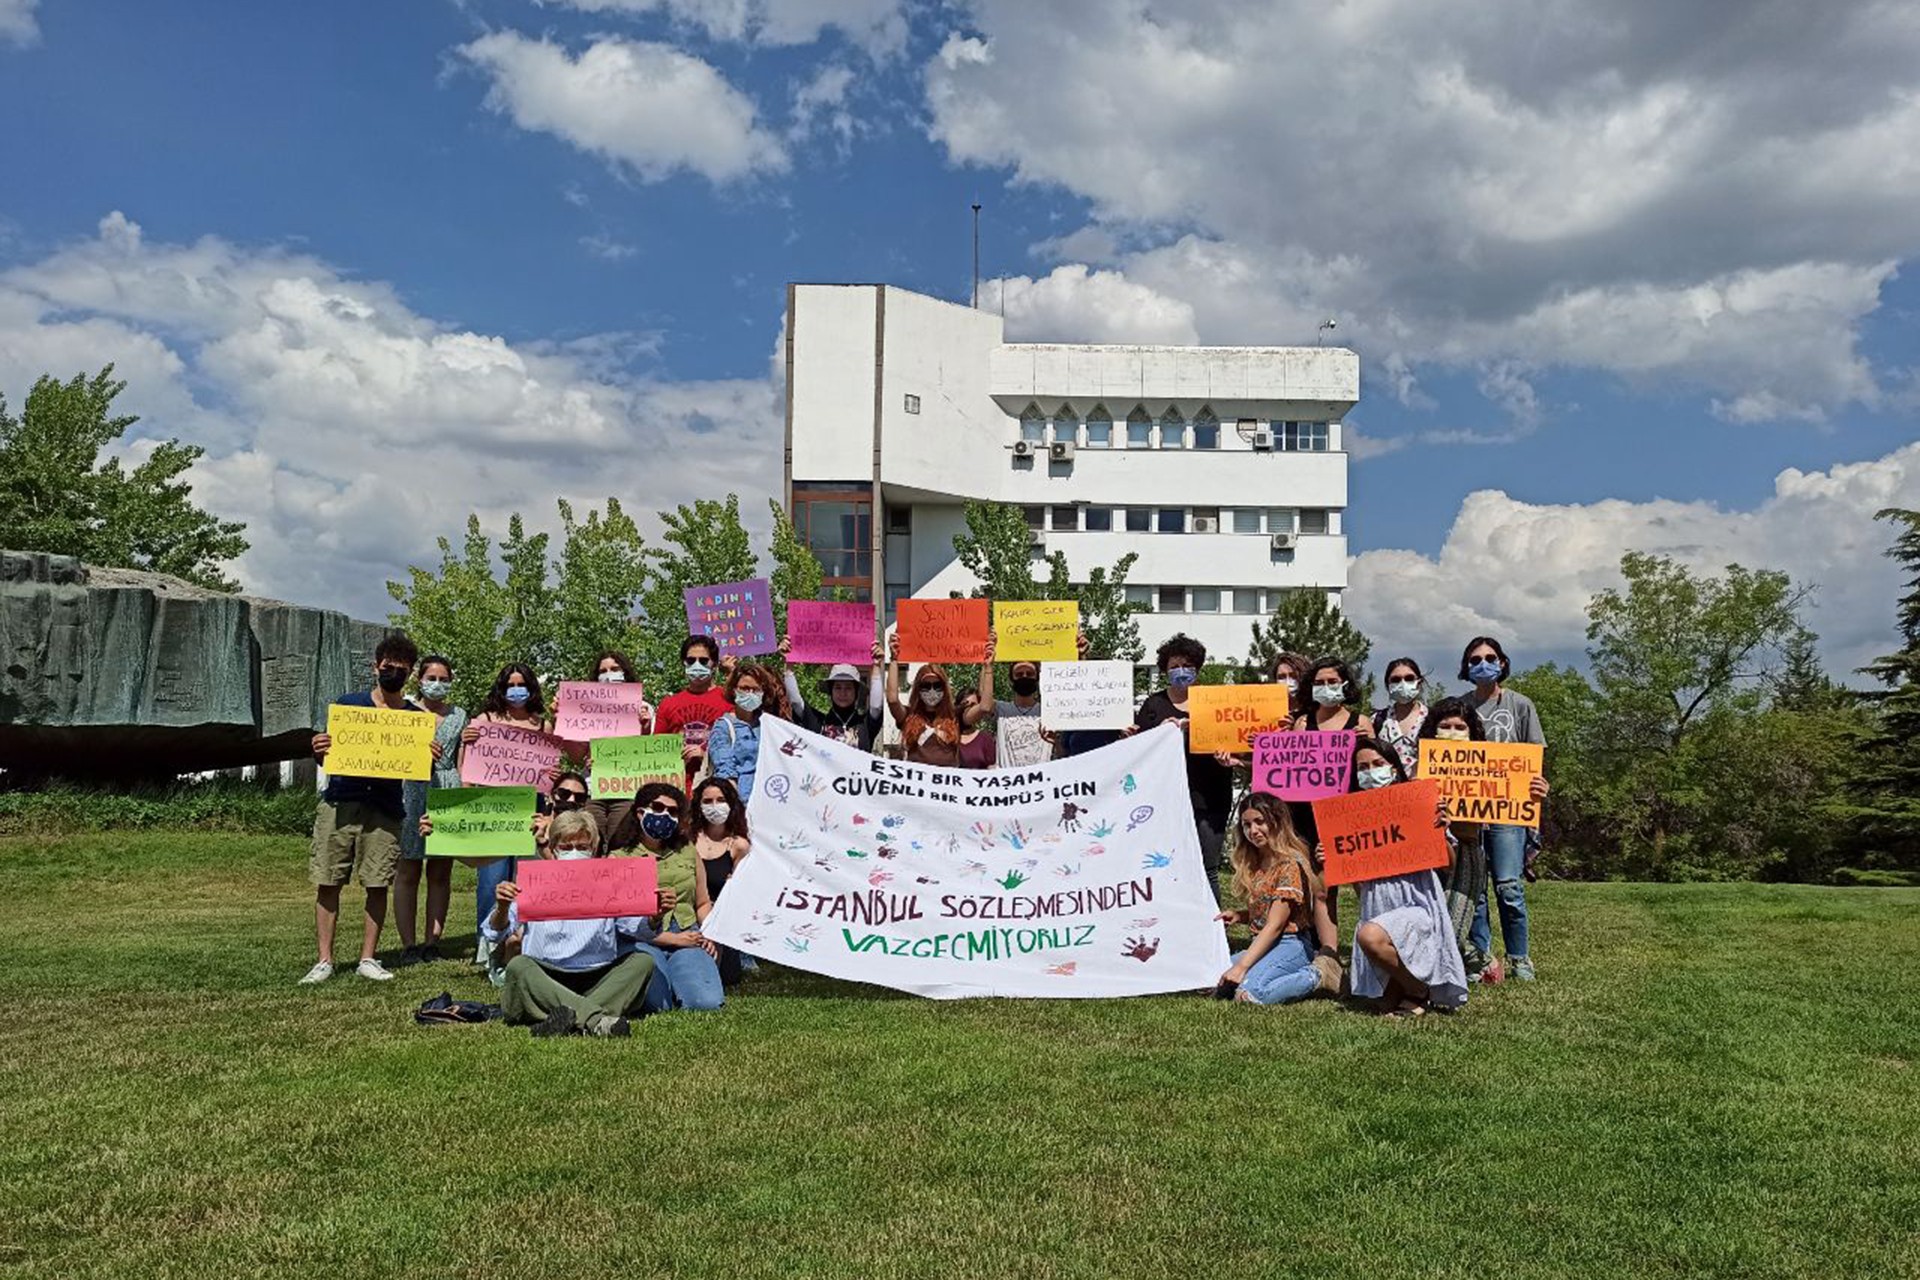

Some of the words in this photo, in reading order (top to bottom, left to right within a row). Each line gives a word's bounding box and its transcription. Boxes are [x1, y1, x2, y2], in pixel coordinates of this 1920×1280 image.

[1428, 748, 1486, 765] KADIN
[1486, 755, 1538, 774] DEĞİL
[965, 790, 1045, 807] KAMPÜS
[1443, 797, 1536, 822] KAMPÜS
[776, 887, 923, 926] İSTANBUL
